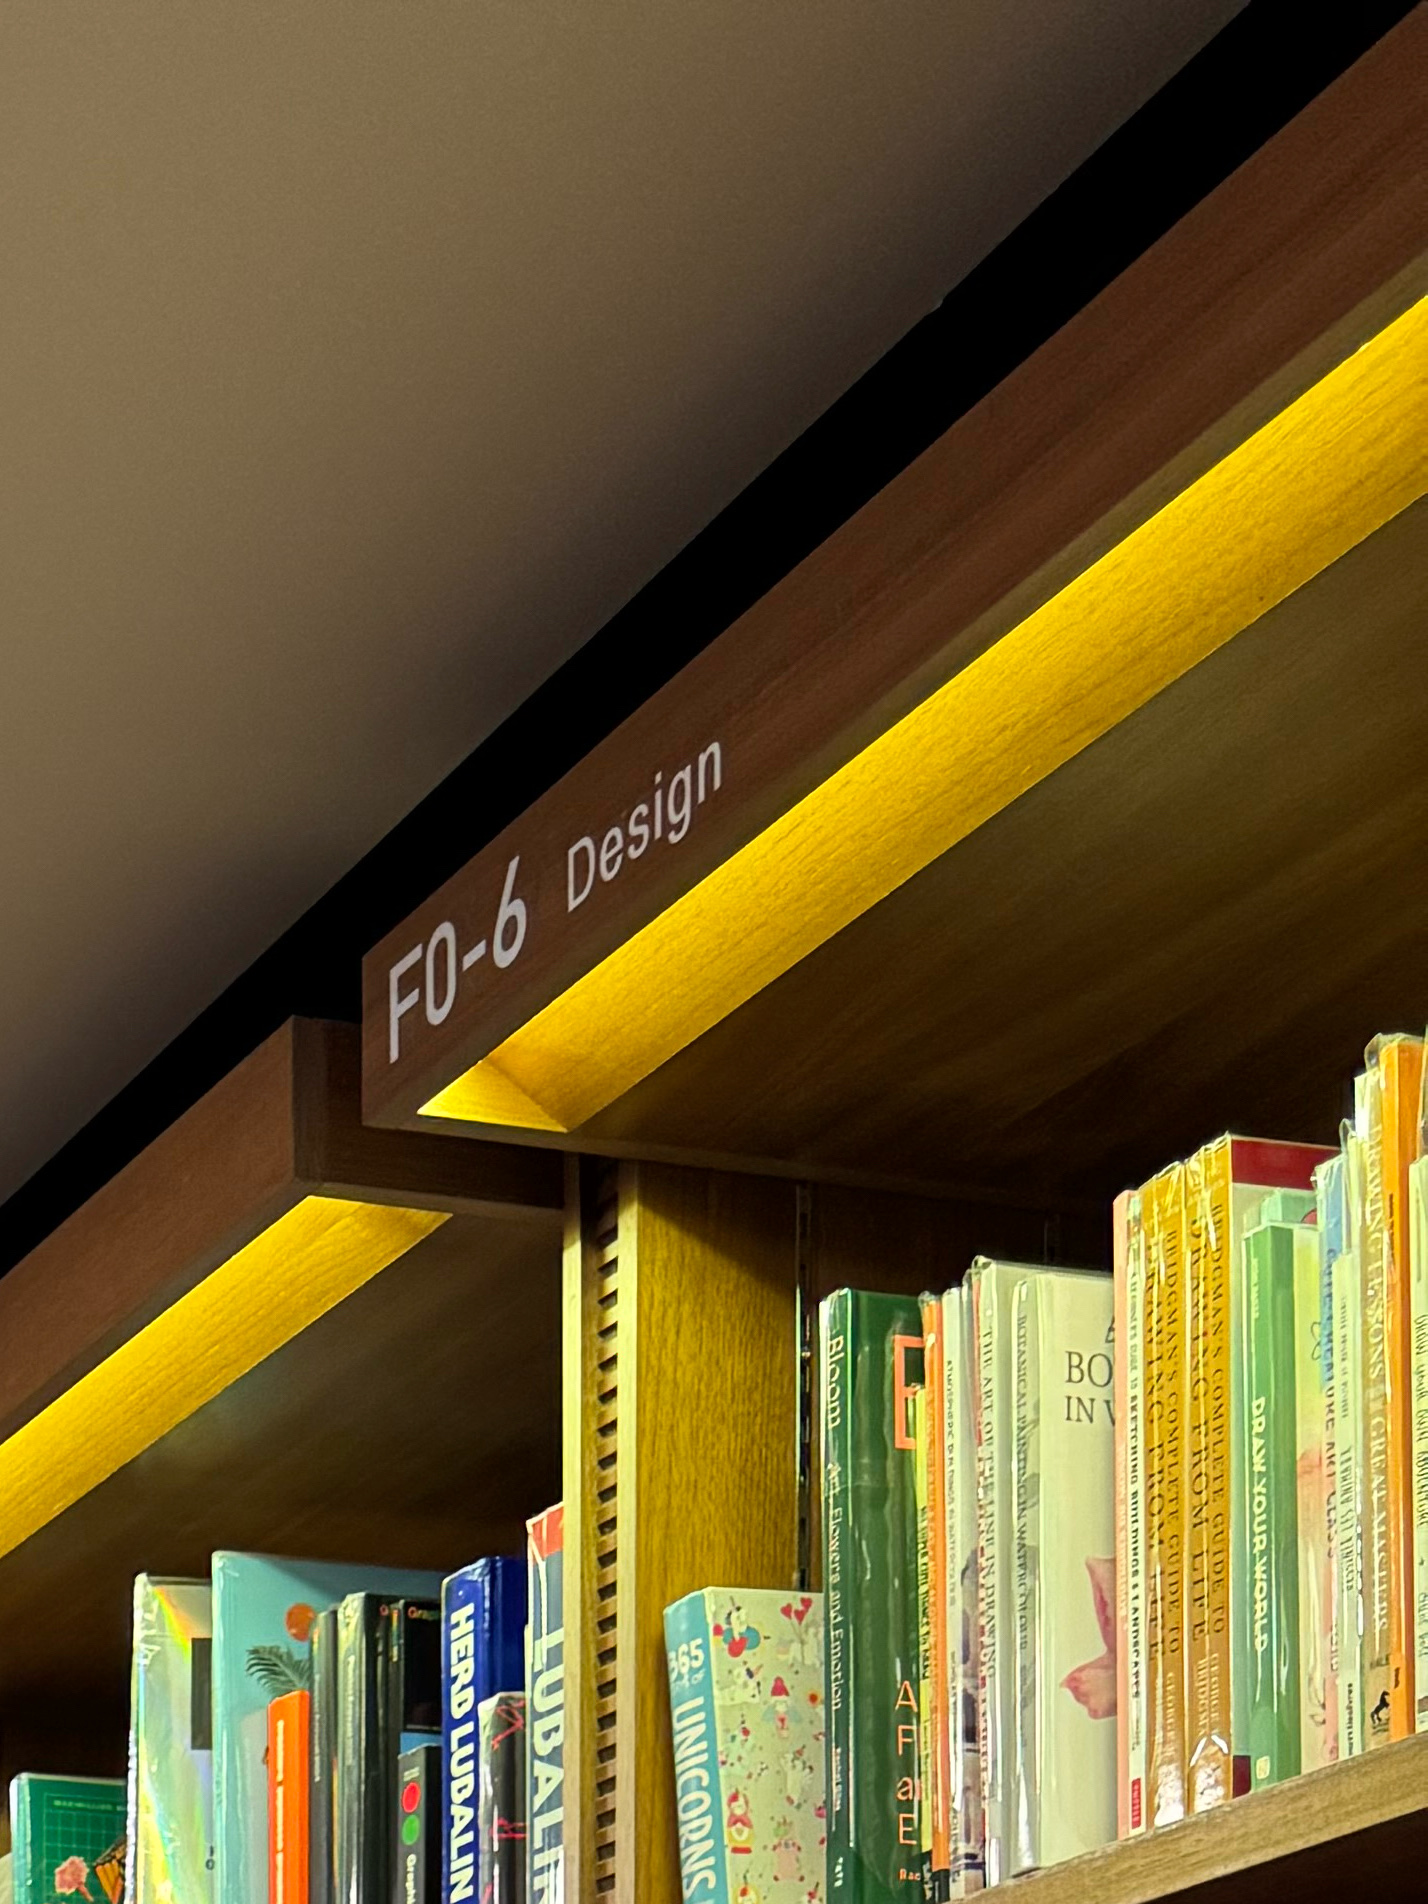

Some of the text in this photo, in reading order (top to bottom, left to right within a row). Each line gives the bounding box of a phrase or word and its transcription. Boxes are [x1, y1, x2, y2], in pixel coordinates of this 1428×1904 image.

[567, 741, 721, 913] Design
[1252, 1397, 1267, 1472] DRAW
[1253, 1483, 1268, 1556] YOUR
[675, 1696, 716, 1900] UNICORNS
